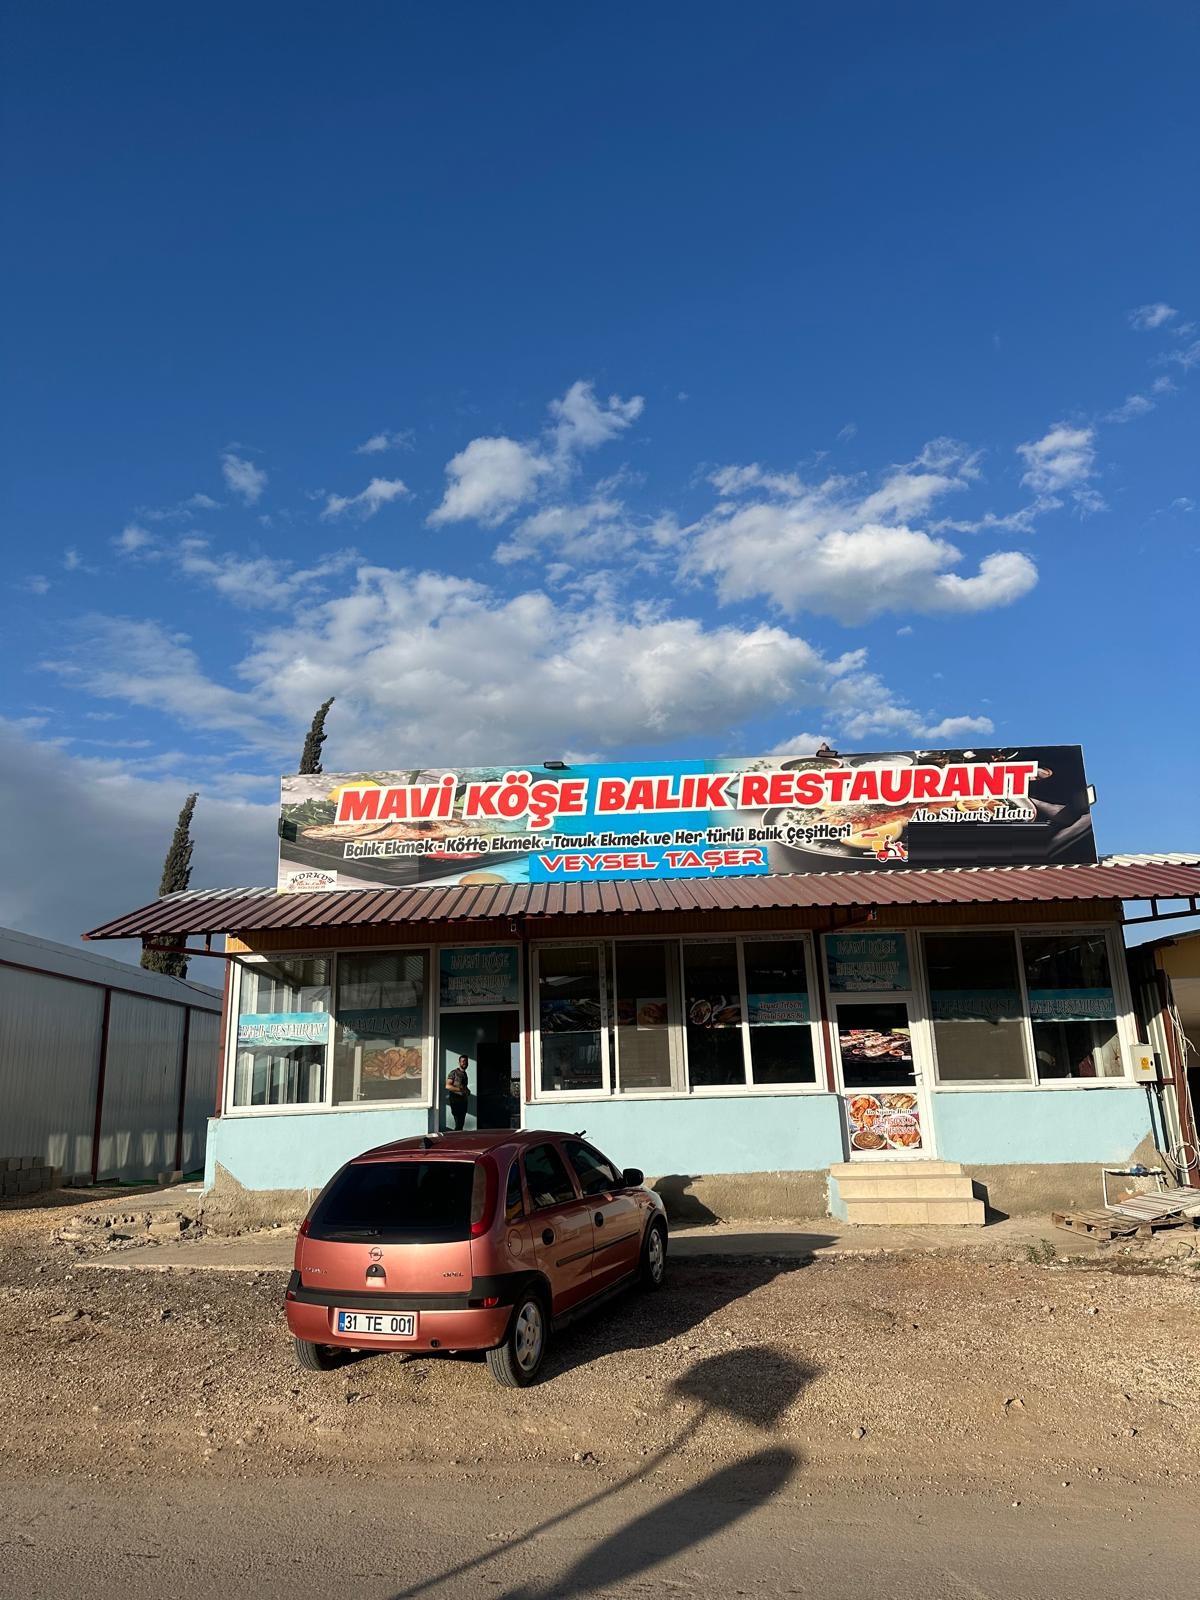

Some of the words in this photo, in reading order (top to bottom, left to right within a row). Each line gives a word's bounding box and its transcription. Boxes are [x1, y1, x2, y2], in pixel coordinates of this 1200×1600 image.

[336, 775, 457, 824] MAVİ
[464, 772, 587, 829] KÖŞE
[596, 775, 731, 813] BALIK
[739, 763, 1036, 807] RESTAURANT
[911, 808, 937, 822] Alo
[940, 806, 991, 823] Sipariş
[993, 805, 1034, 820] Hattı
[344, 841, 382, 858] Balık
[384, 838, 434, 855] Ekmek
[446, 836, 488, 854] Köfte
[491, 835, 542, 851] Ekmek
[553, 832, 600, 848] Tavuk
[600, 831, 652, 847] Ekmek
[653, 833, 672, 846] ve
[674, 830, 703, 846] Her
[706, 826, 745, 844] türlü
[748, 825, 783, 842] Balık
[786, 823, 852, 845] Çeşitleri
[539, 853, 658, 873] VEYSEL
[664, 849, 764, 873] TAŞER
[345, 1314, 358, 1330] 31
[365, 1315, 384, 1332] TE
[390, 1317, 412, 1334] 001
